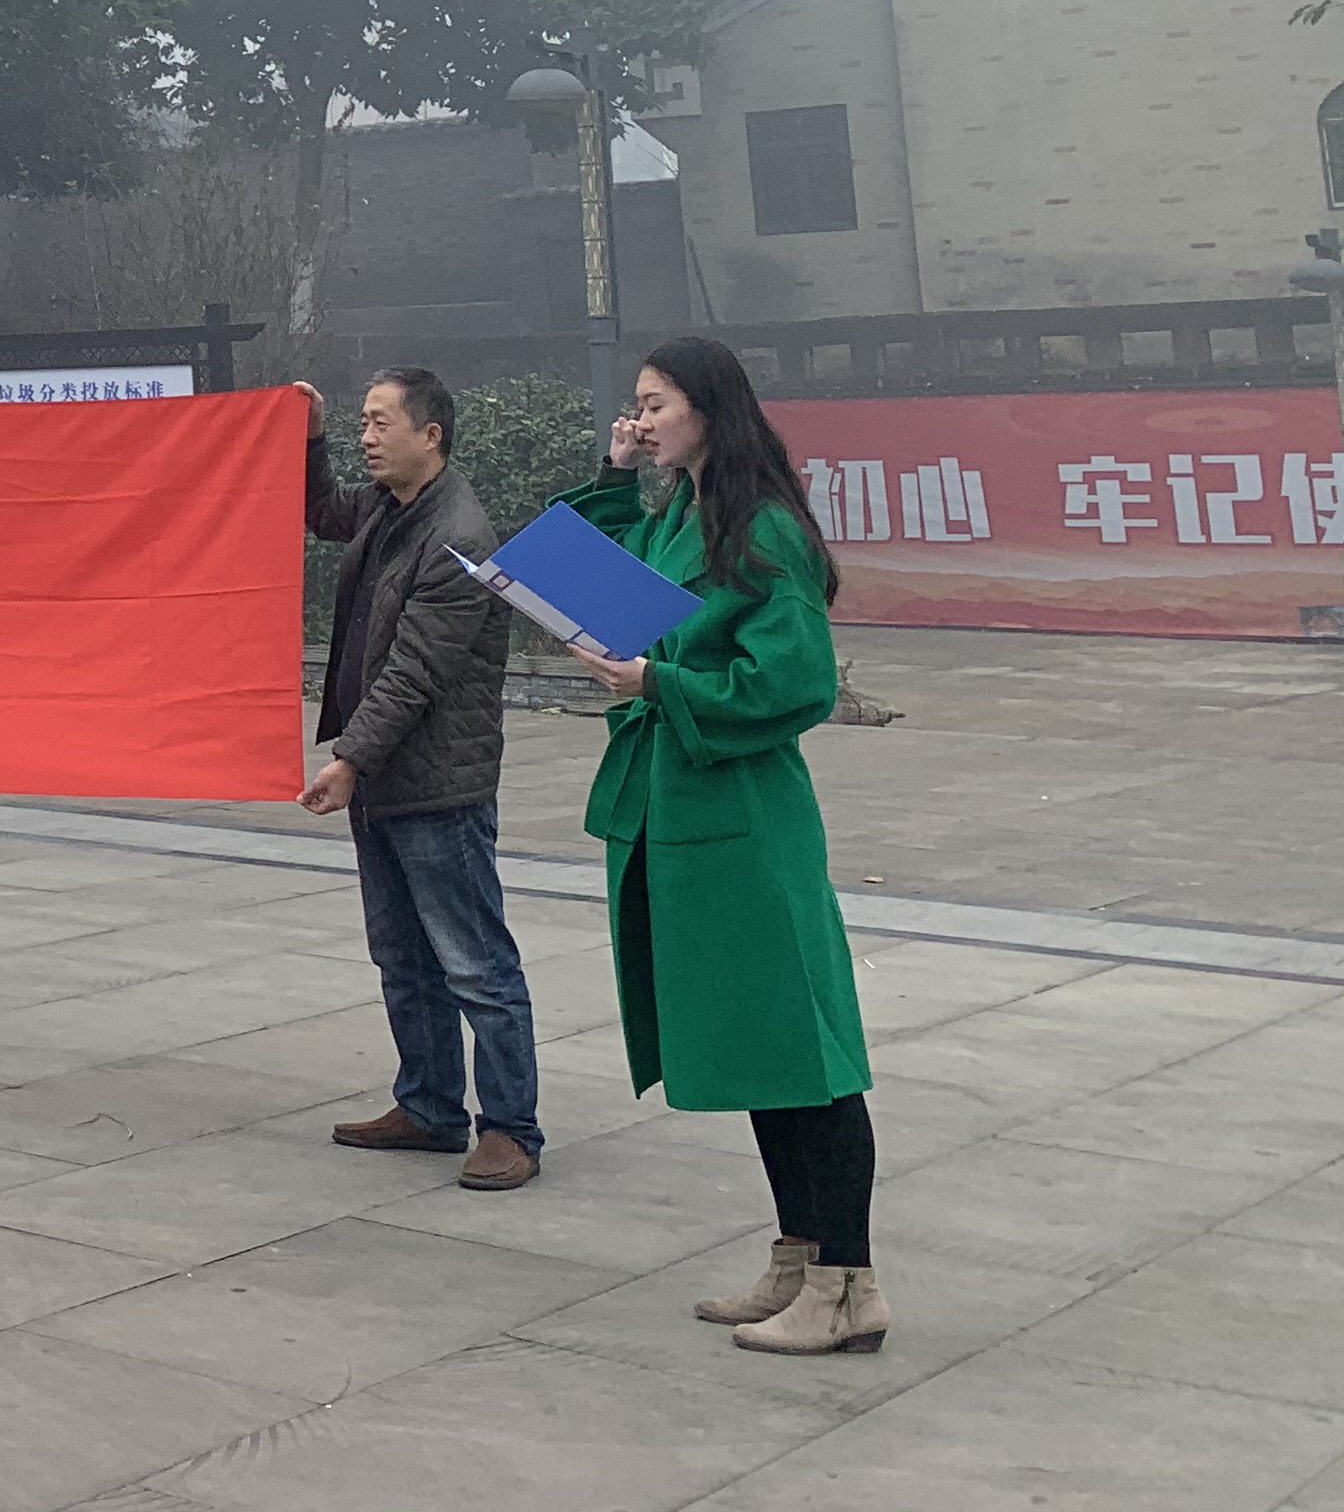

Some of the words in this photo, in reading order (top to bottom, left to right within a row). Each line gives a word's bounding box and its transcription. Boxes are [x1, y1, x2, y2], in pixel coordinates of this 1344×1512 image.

[801, 456, 992, 542] 初心
[1057, 452, 1344, 545] 牢记使
